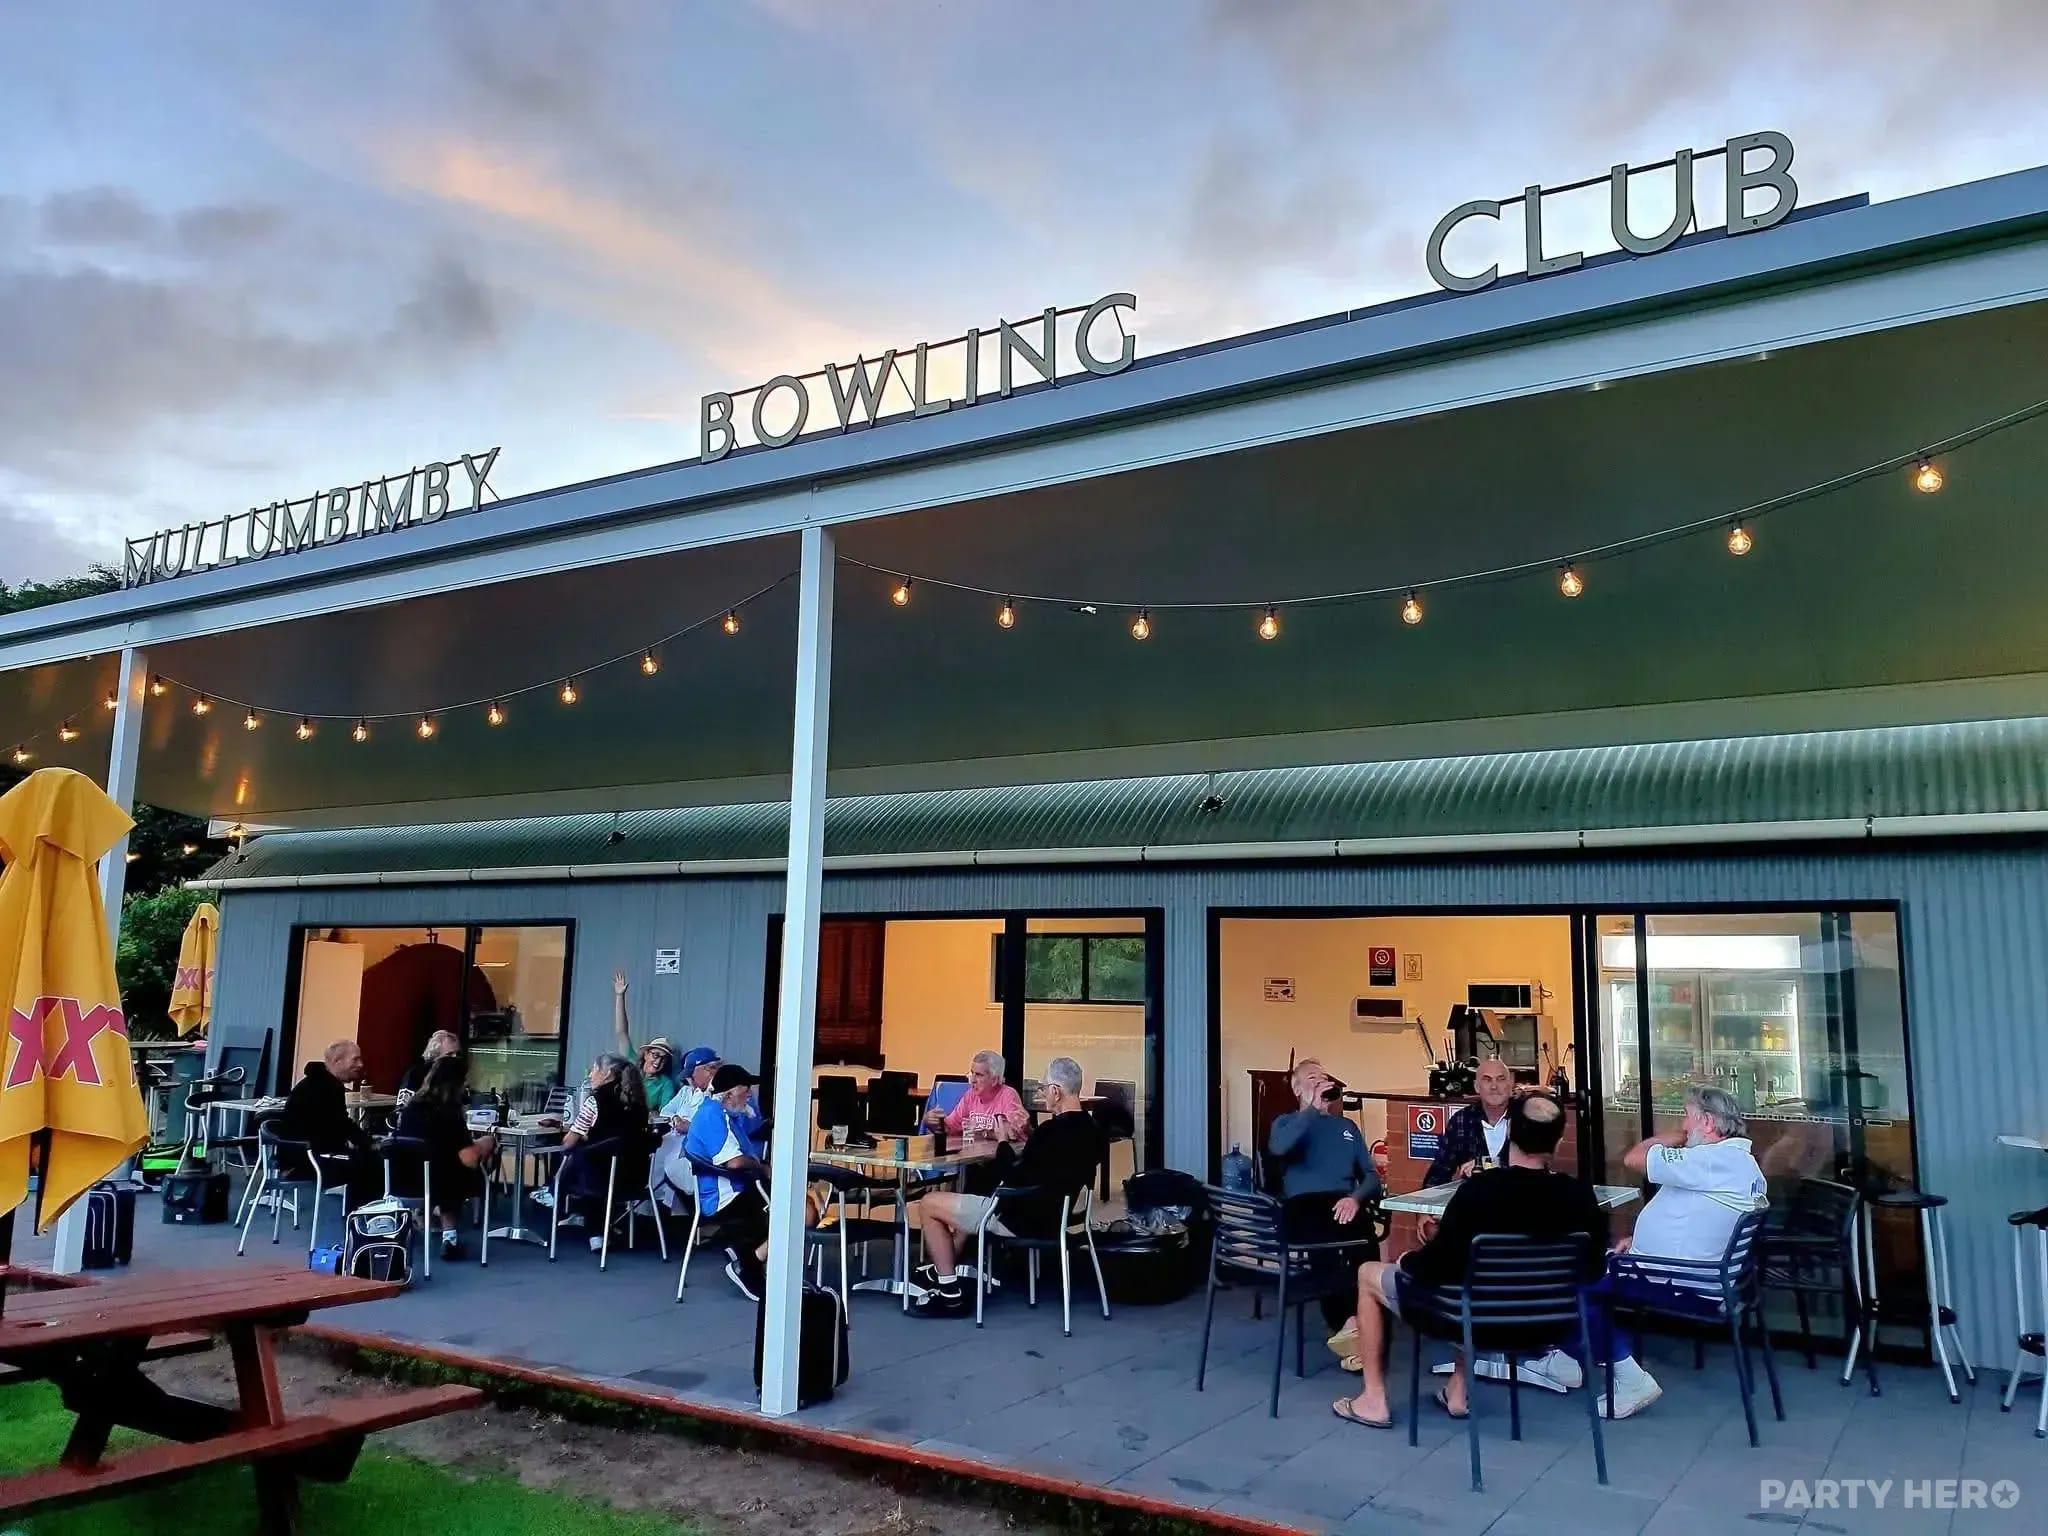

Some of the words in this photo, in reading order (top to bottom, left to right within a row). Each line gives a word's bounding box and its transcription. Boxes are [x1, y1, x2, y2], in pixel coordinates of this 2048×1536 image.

[121, 446, 501, 590] MULLUMBIMBY
[700, 292, 1137, 464] BOWLING
[1426, 131, 1799, 293] CLUB
